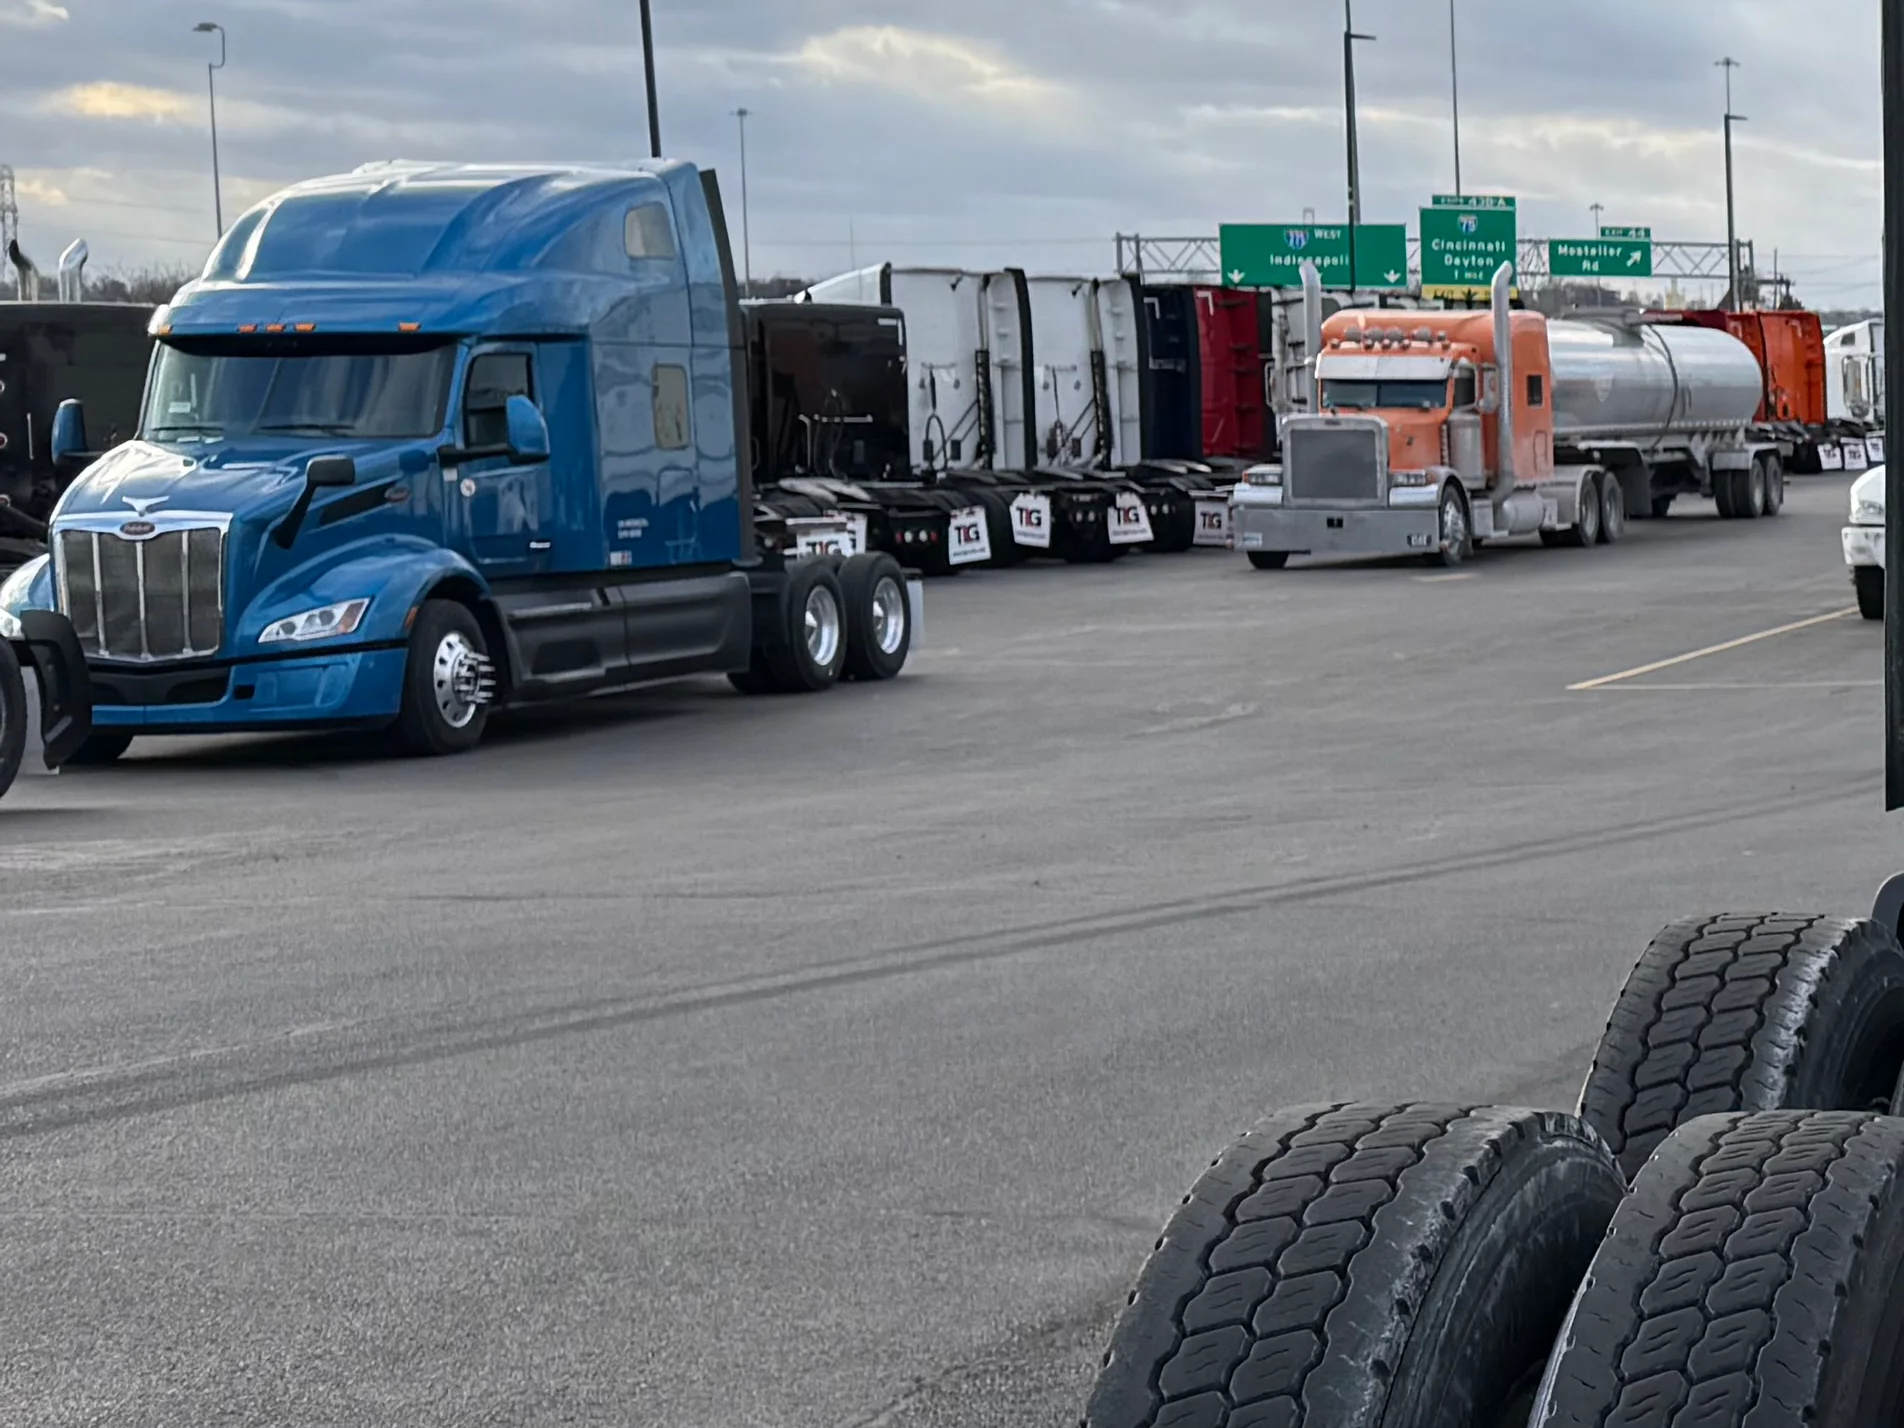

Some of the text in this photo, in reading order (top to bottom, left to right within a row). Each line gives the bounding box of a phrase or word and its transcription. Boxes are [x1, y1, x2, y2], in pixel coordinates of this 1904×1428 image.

[1314, 229, 1342, 239] WEST
[1431, 238, 1506, 252] Cincinnati
[1558, 243, 1622, 257] Mosteller
[1270, 253, 1350, 268] Indiapoli
[1444, 254, 1494, 267] Dayton
[1582, 259, 1600, 272] Rd
[1016, 506, 1043, 527] TLG
[1116, 505, 1141, 526] TLG
[953, 522, 981, 547] TLG
